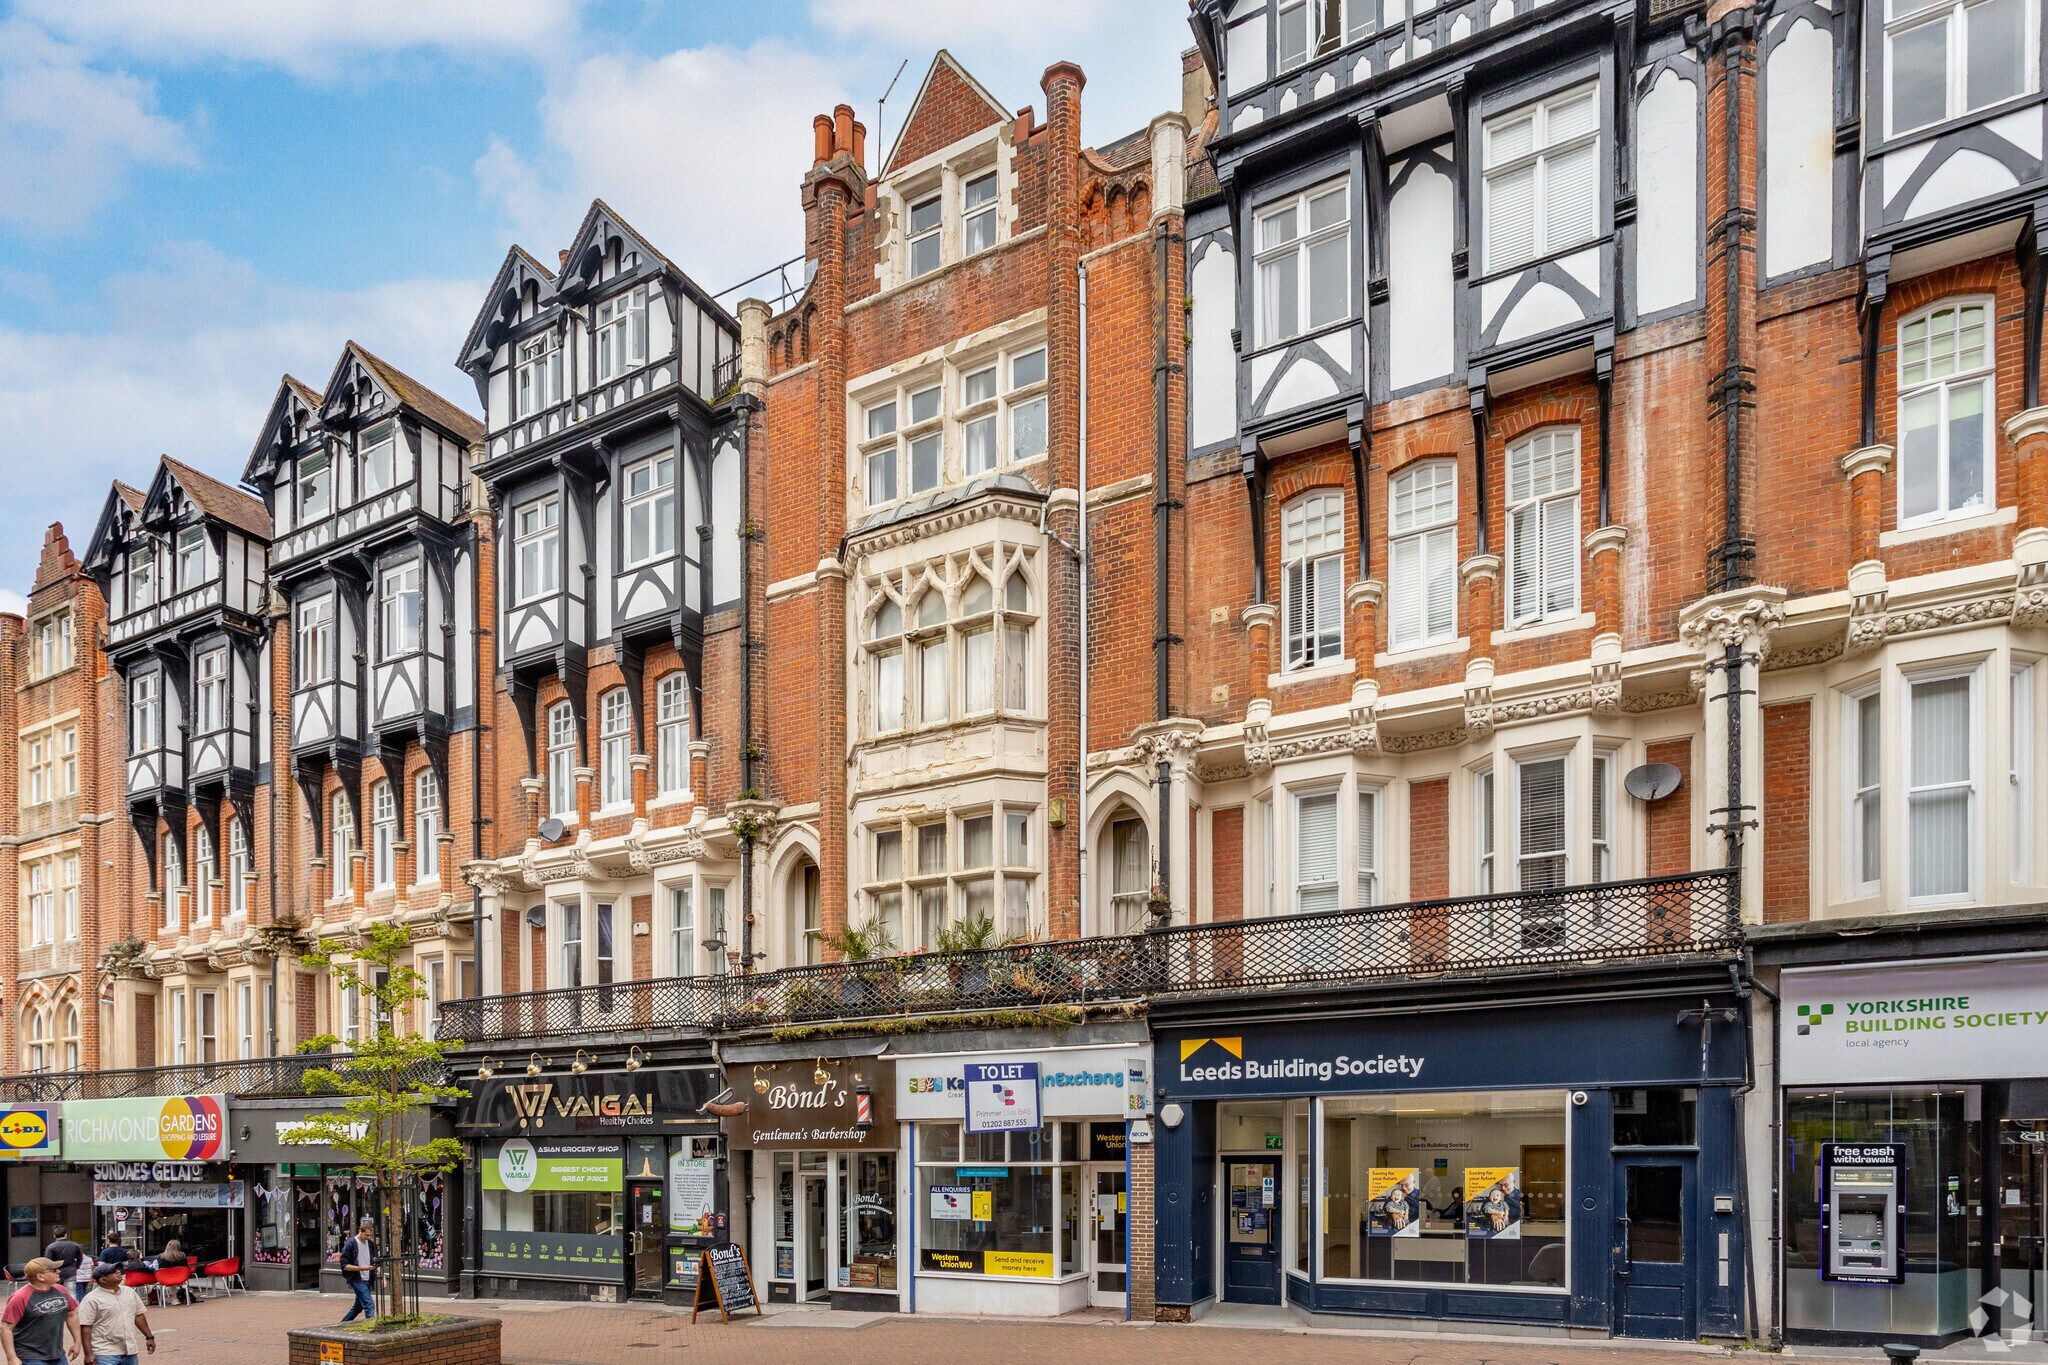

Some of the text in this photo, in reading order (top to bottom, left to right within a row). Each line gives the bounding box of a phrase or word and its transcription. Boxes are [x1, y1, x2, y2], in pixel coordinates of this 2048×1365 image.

[1846, 996, 1969, 1015] YORKSHIRE
[1846, 1011, 2048, 1033] BUILDING SOCIETY
[1846, 1038, 1909, 1048] local agency
[979, 1065, 1023, 1079] TO LET
[1181, 1054, 1424, 1081] Leeds Building Society
[768, 1080, 847, 1109] Bond's
[552, 1093, 652, 1117] VAIGAI
[66, 1116, 158, 1143] RICHMOND
[160, 1113, 217, 1132] GARDENS
[600, 1116, 654, 1127] Healthy Choices
[187, 1133, 198, 1141] AND
[199, 1132, 217, 1140] LEISURE
[753, 1127, 866, 1144] Gentlemen's Barbershop
[1833, 1146, 1894, 1156] free cash
[94, 1162, 203, 1181] SUNDAES GELATO
[853, 1193, 882, 1204] Bond's
[711, 1244, 740, 1261] Bond's
[931, 1253, 959, 1261] Western
